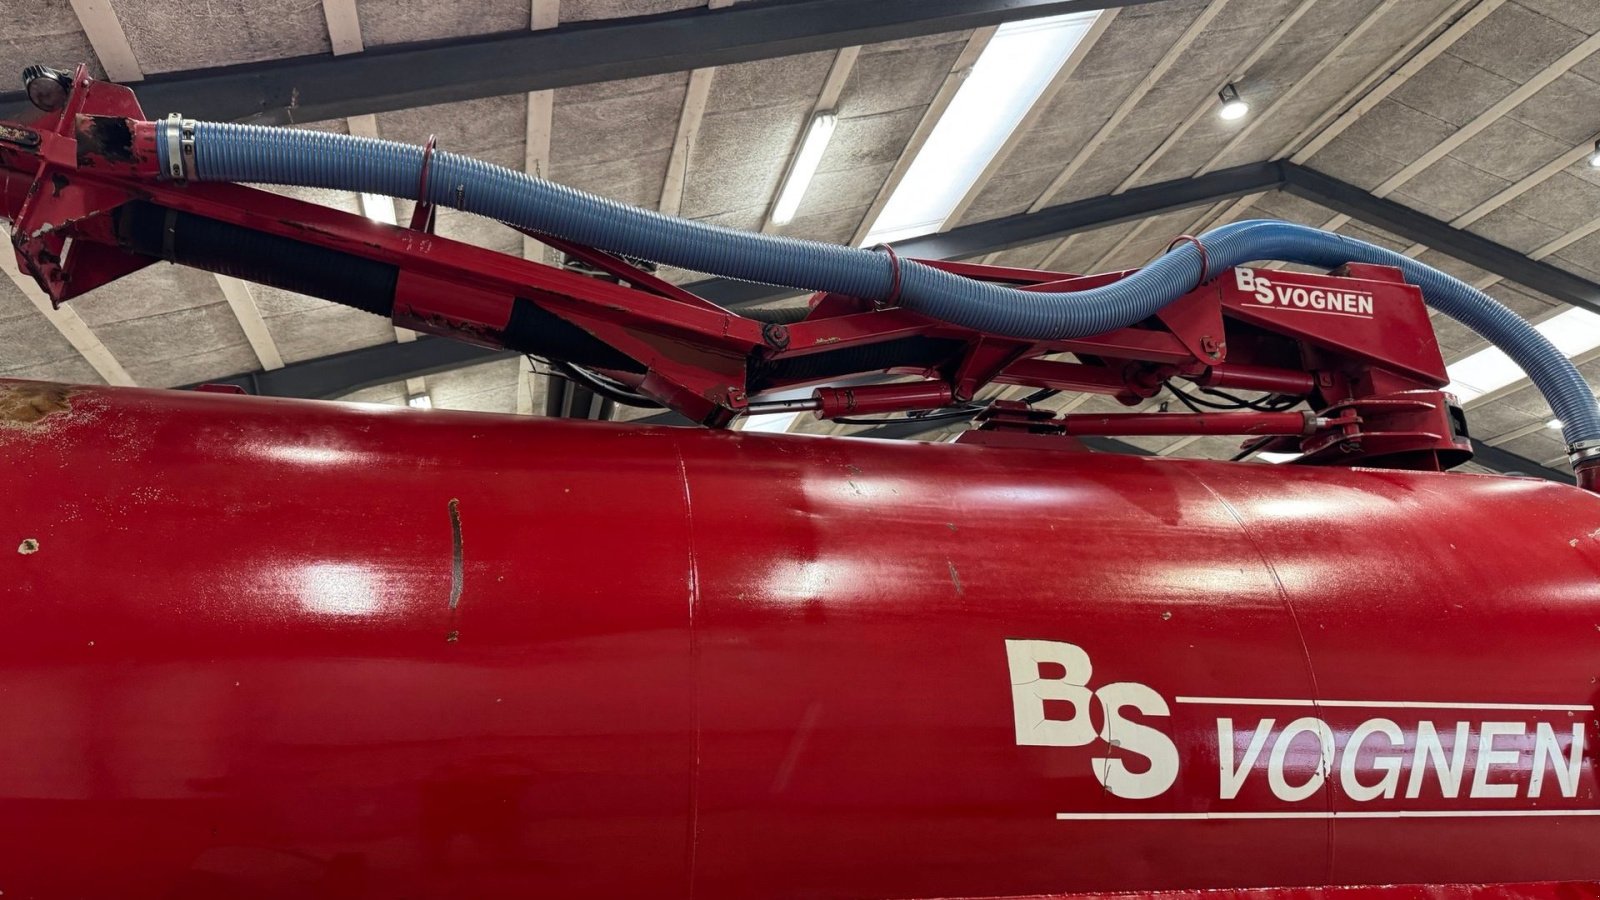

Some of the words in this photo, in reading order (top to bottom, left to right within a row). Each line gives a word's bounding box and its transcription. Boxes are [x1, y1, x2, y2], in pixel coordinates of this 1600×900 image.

[1235, 267, 1274, 304] BS
[1276, 288, 1374, 314] VOGNEN
[1005, 638, 1180, 800] BS
[1216, 716, 1585, 802] VOGNEN
